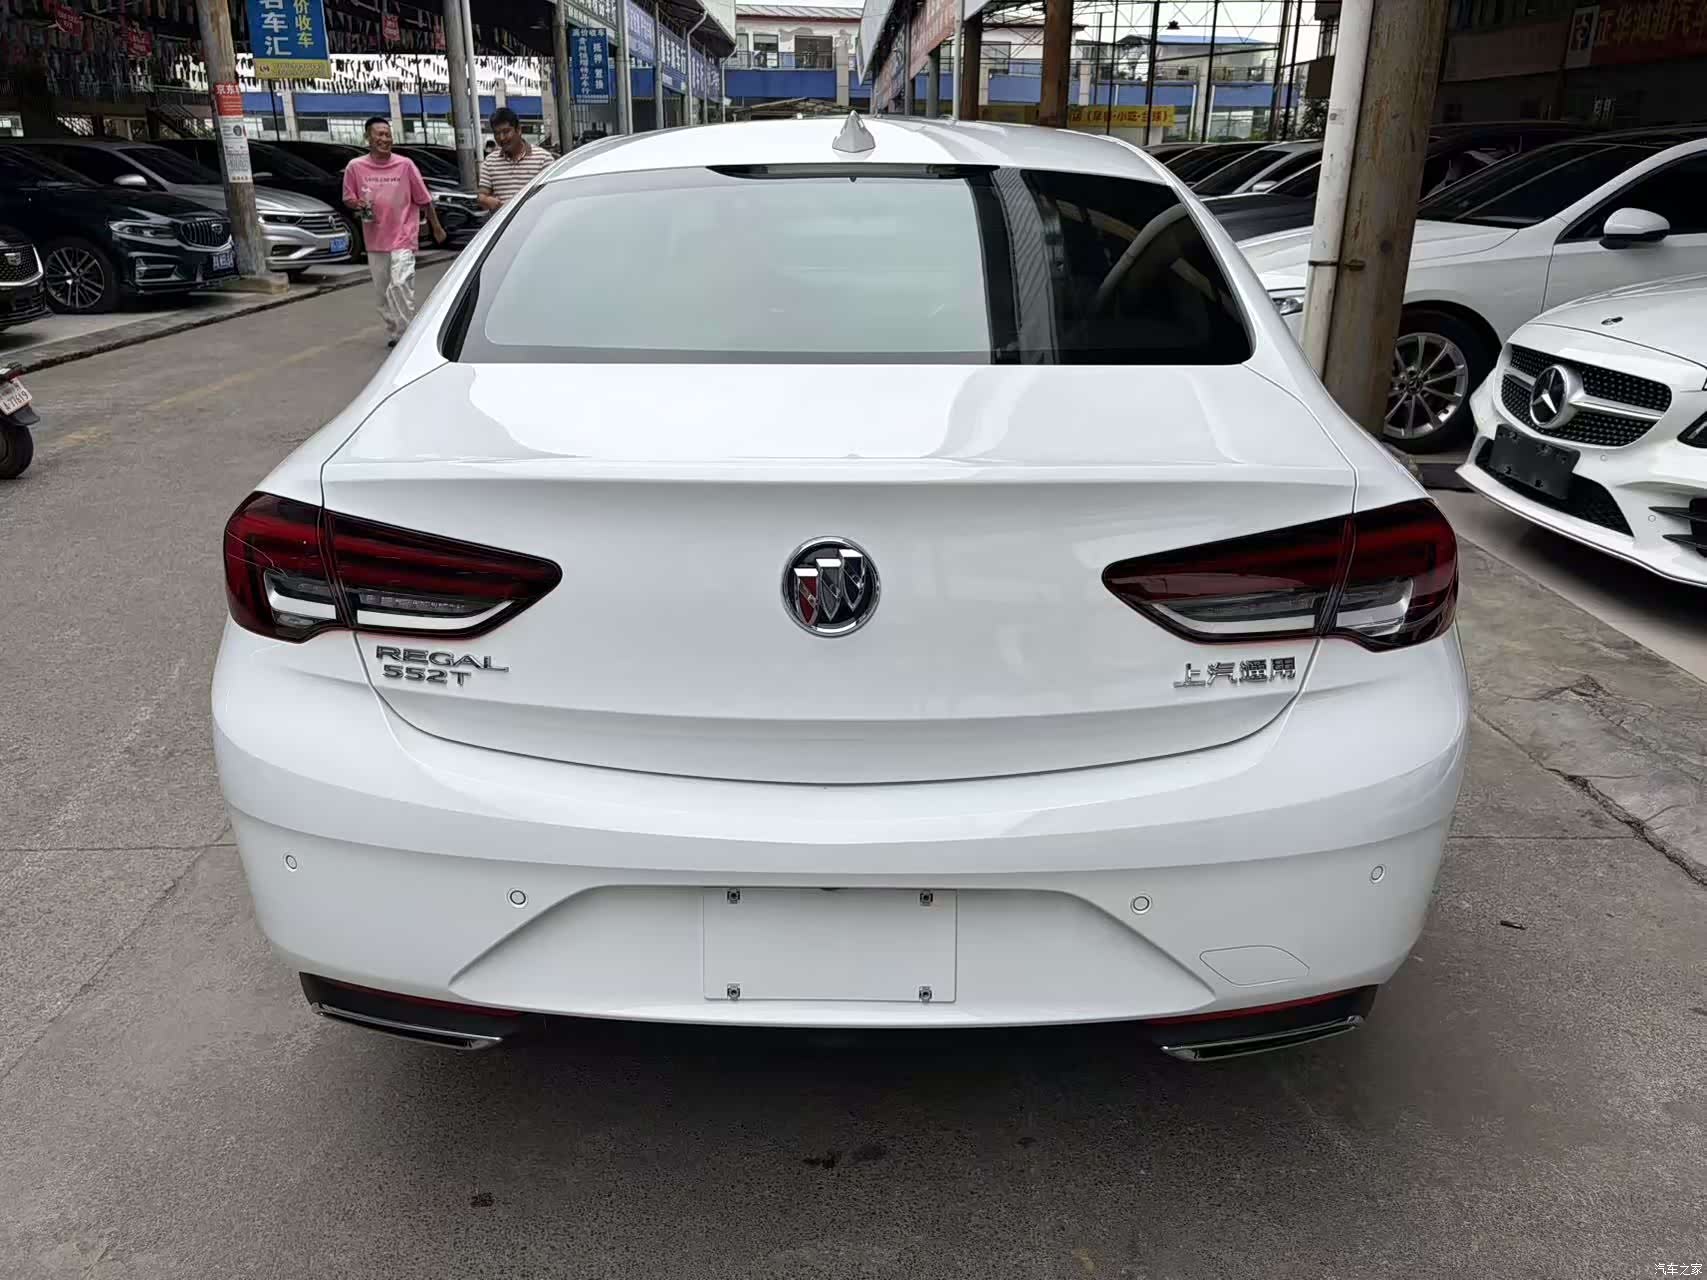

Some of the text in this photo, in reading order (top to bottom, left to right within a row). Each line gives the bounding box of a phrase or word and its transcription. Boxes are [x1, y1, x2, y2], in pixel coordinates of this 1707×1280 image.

[376, 645, 510, 673] REGAL
[1173, 656, 1296, 688] 上汽通用
[383, 664, 472, 687] 552T
